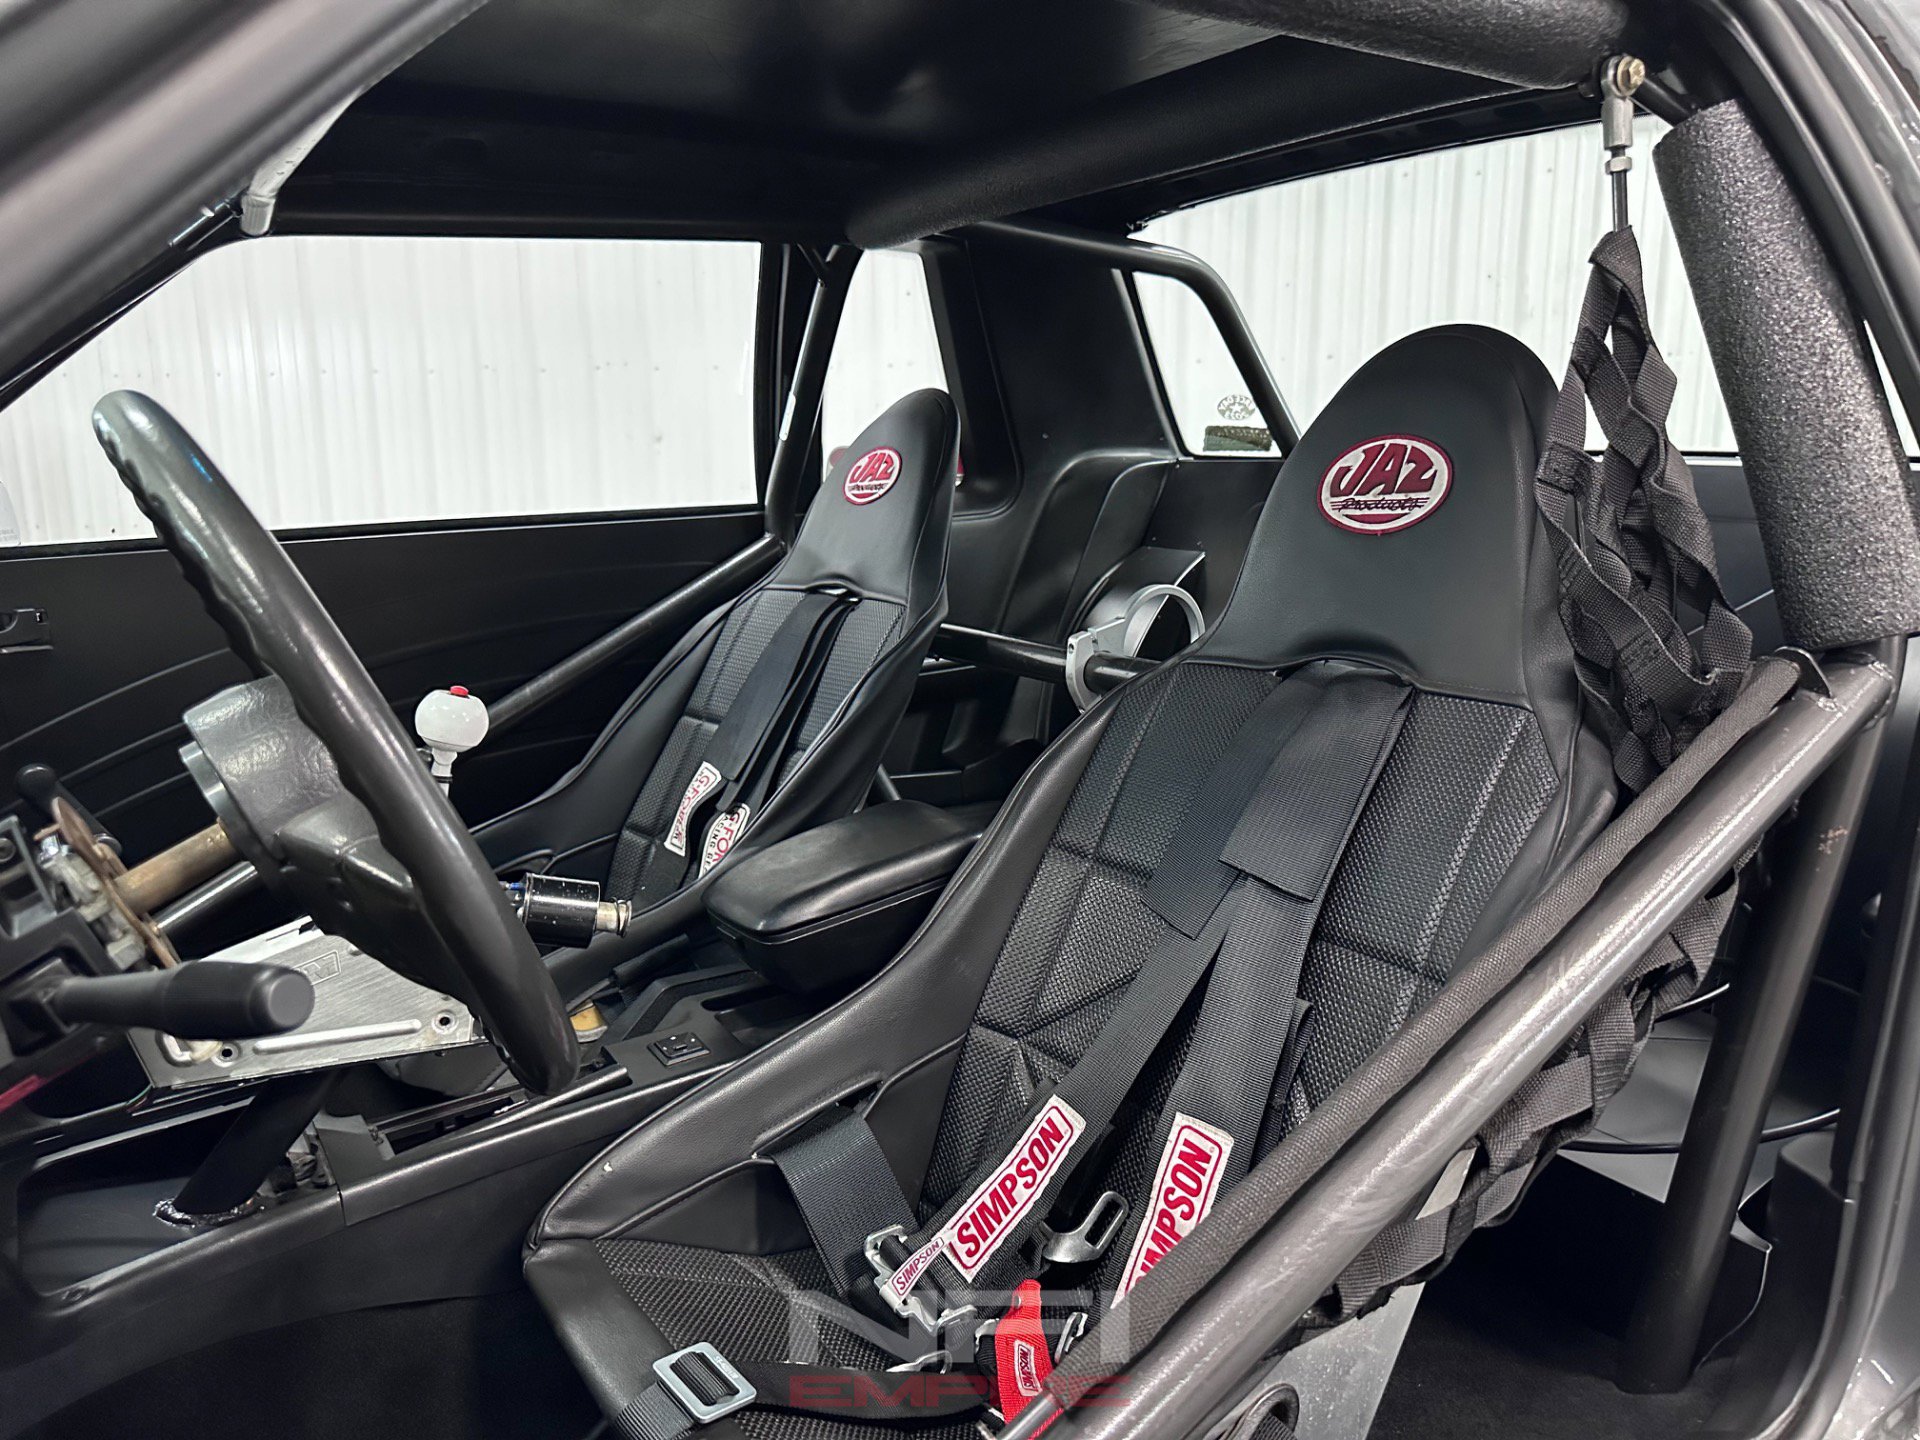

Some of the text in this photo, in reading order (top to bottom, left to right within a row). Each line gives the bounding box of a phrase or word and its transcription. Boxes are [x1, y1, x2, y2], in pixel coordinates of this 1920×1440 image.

[849, 453, 894, 483] JAZ
[1330, 443, 1437, 497] JAZ
[957, 1117, 1065, 1258] SIMPSON
[896, 1241, 940, 1290] SIMPSON
